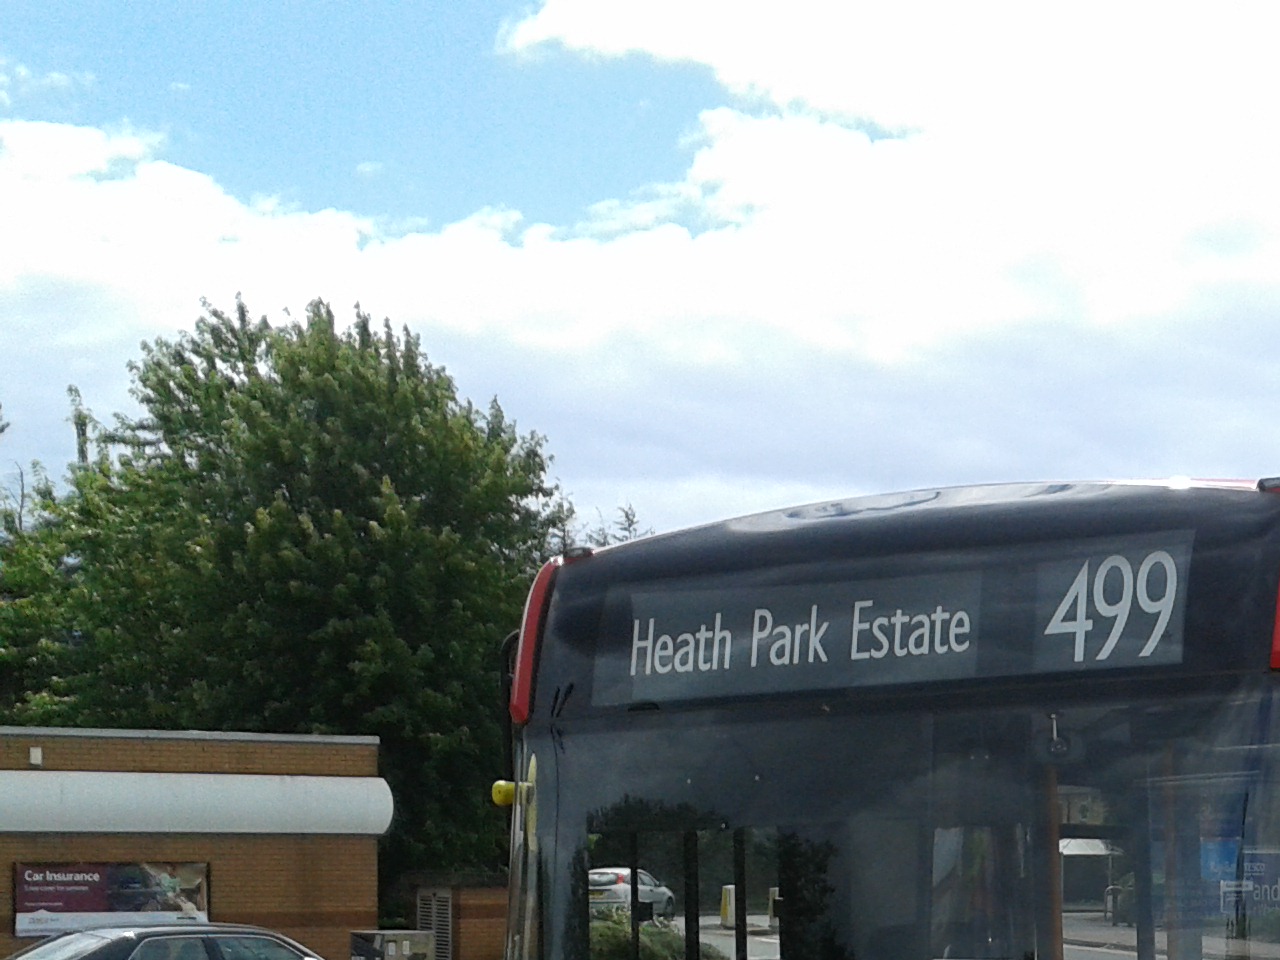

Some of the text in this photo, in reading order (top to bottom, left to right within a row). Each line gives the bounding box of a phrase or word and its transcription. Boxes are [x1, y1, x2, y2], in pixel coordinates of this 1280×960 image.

[630, 600, 970, 677] Heath Park Estate
[1044, 550, 1178, 663] 499
[24, 870, 100, 882] Car Insurance
